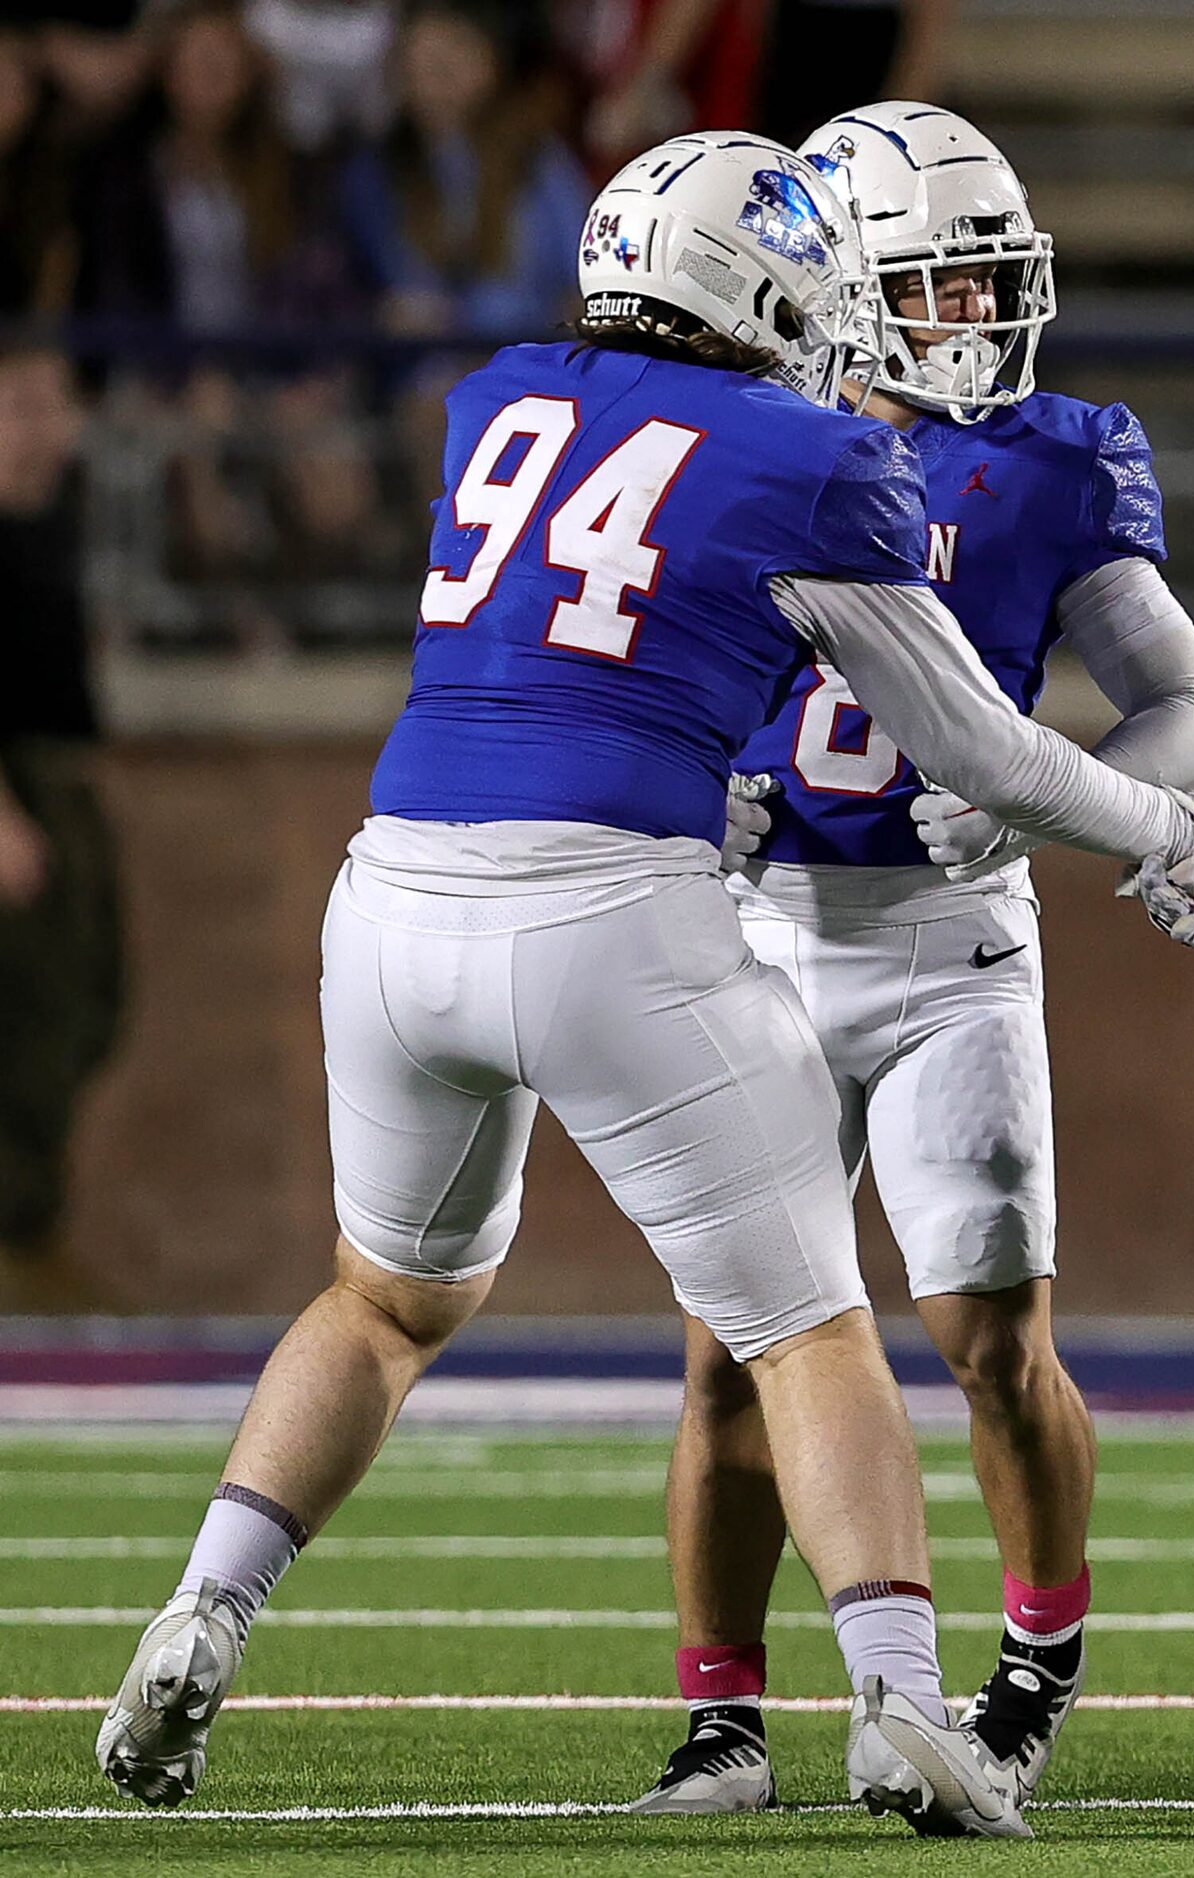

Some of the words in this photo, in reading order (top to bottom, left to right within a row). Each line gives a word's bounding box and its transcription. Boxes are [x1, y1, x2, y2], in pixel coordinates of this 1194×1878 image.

[597, 214, 622, 239] 94
[586, 292, 642, 318] schutt
[778, 362, 807, 391] chutt
[419, 393, 708, 664] 94
